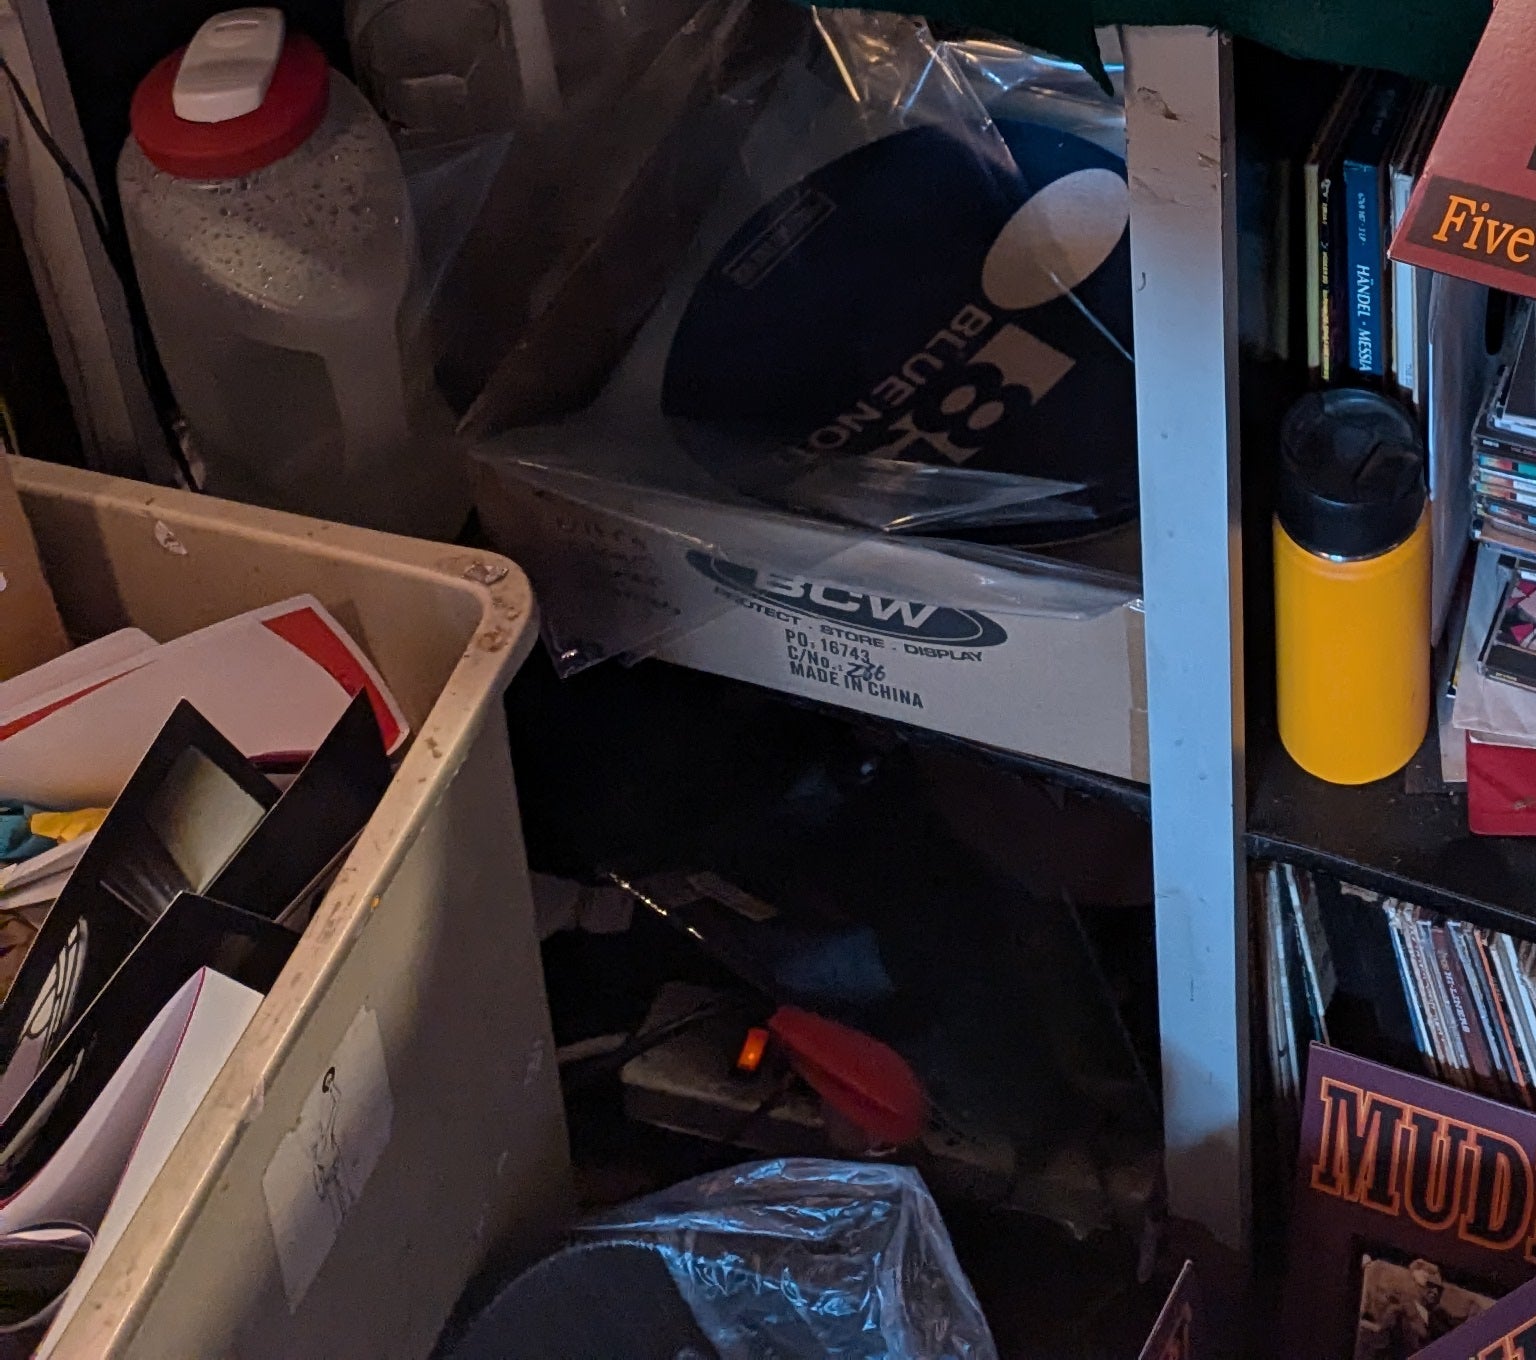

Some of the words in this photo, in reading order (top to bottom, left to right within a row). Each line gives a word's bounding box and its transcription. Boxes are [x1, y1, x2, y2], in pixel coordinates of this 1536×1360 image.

[1432, 194, 1536, 264] Five
[1356, 263, 1372, 317] HÄNDEL
[808, 303, 993, 451] BLUENO
[767, 573, 941, 629] BCW
[819, 624, 885, 648] STORE
[903, 642, 984, 663] DISPLAY
[821, 637, 871, 664] 16743
[789, 660, 840, 687] MADE
[844, 673, 864, 694] IN
[867, 678, 925, 710] CHINA
